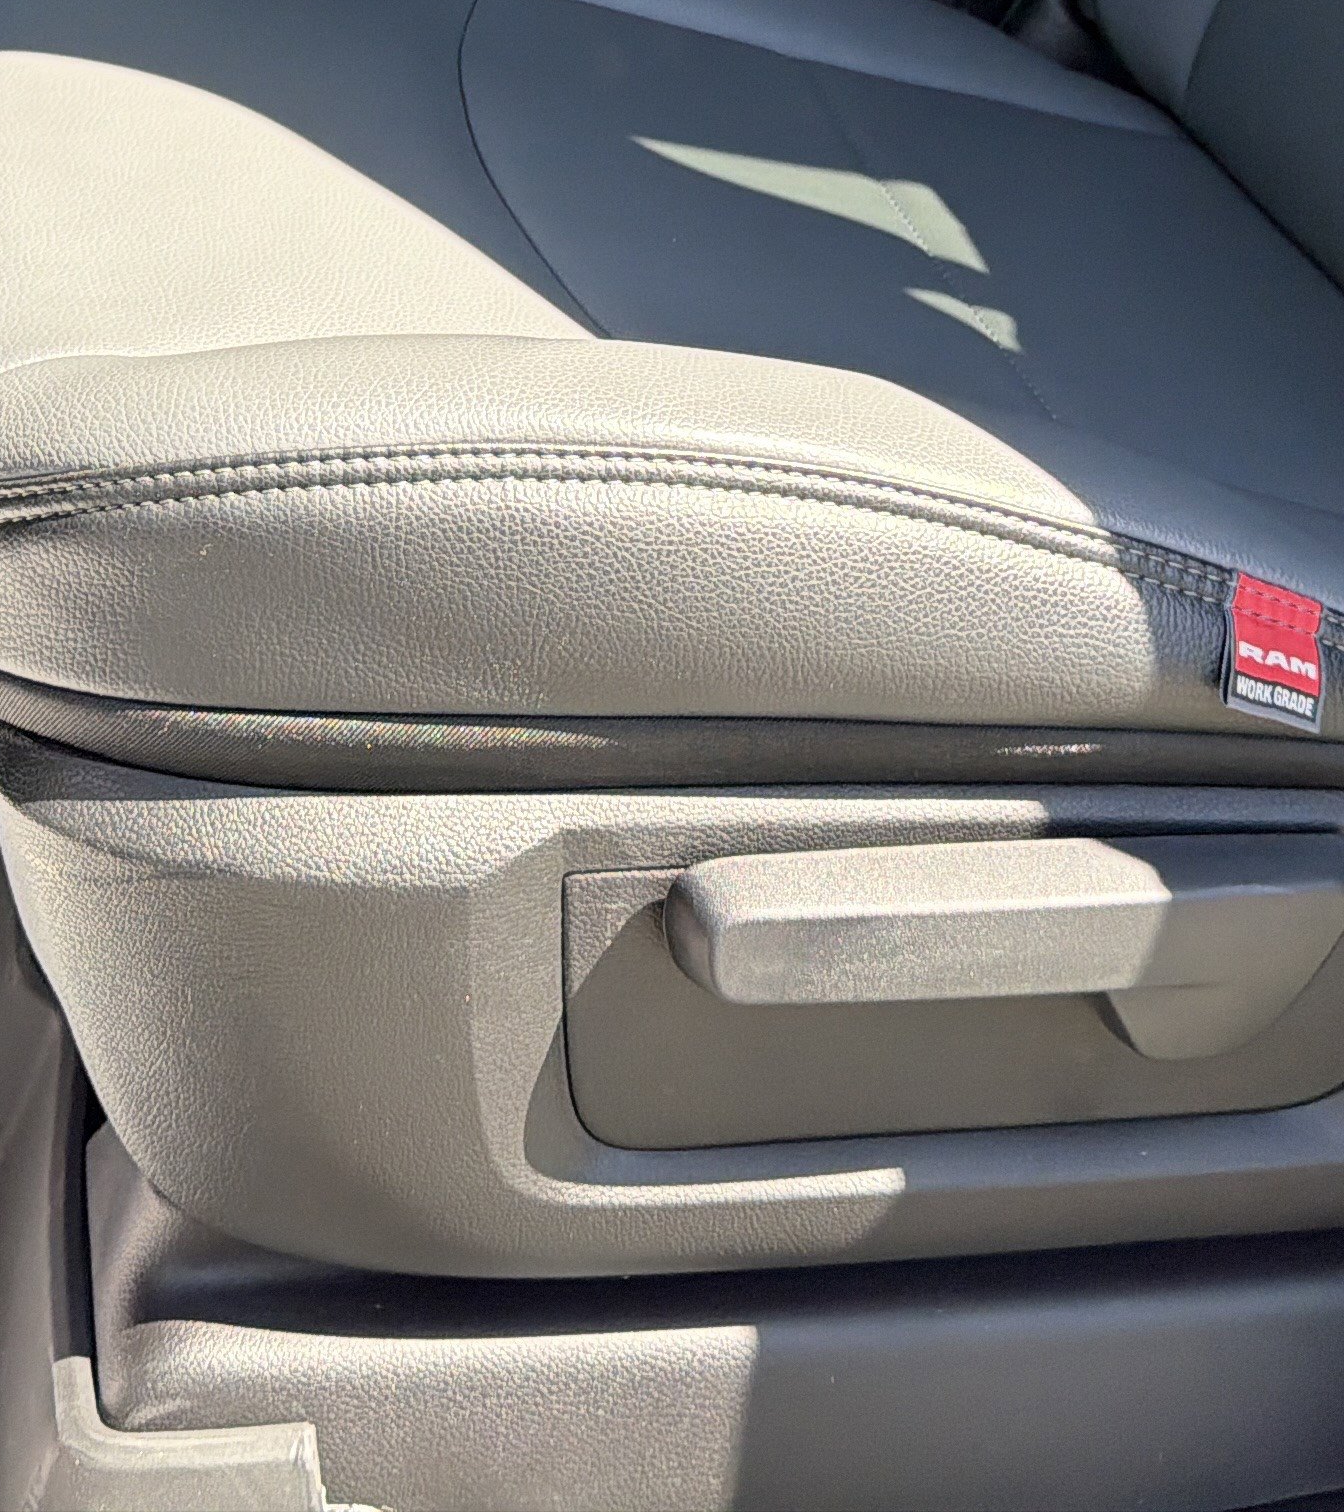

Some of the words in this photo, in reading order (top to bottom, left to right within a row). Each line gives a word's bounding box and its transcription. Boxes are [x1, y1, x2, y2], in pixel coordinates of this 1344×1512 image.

[1238, 640, 1318, 680] RAM
[1236, 675, 1273, 705] WORK
[1273, 685, 1315, 718] GRADE
